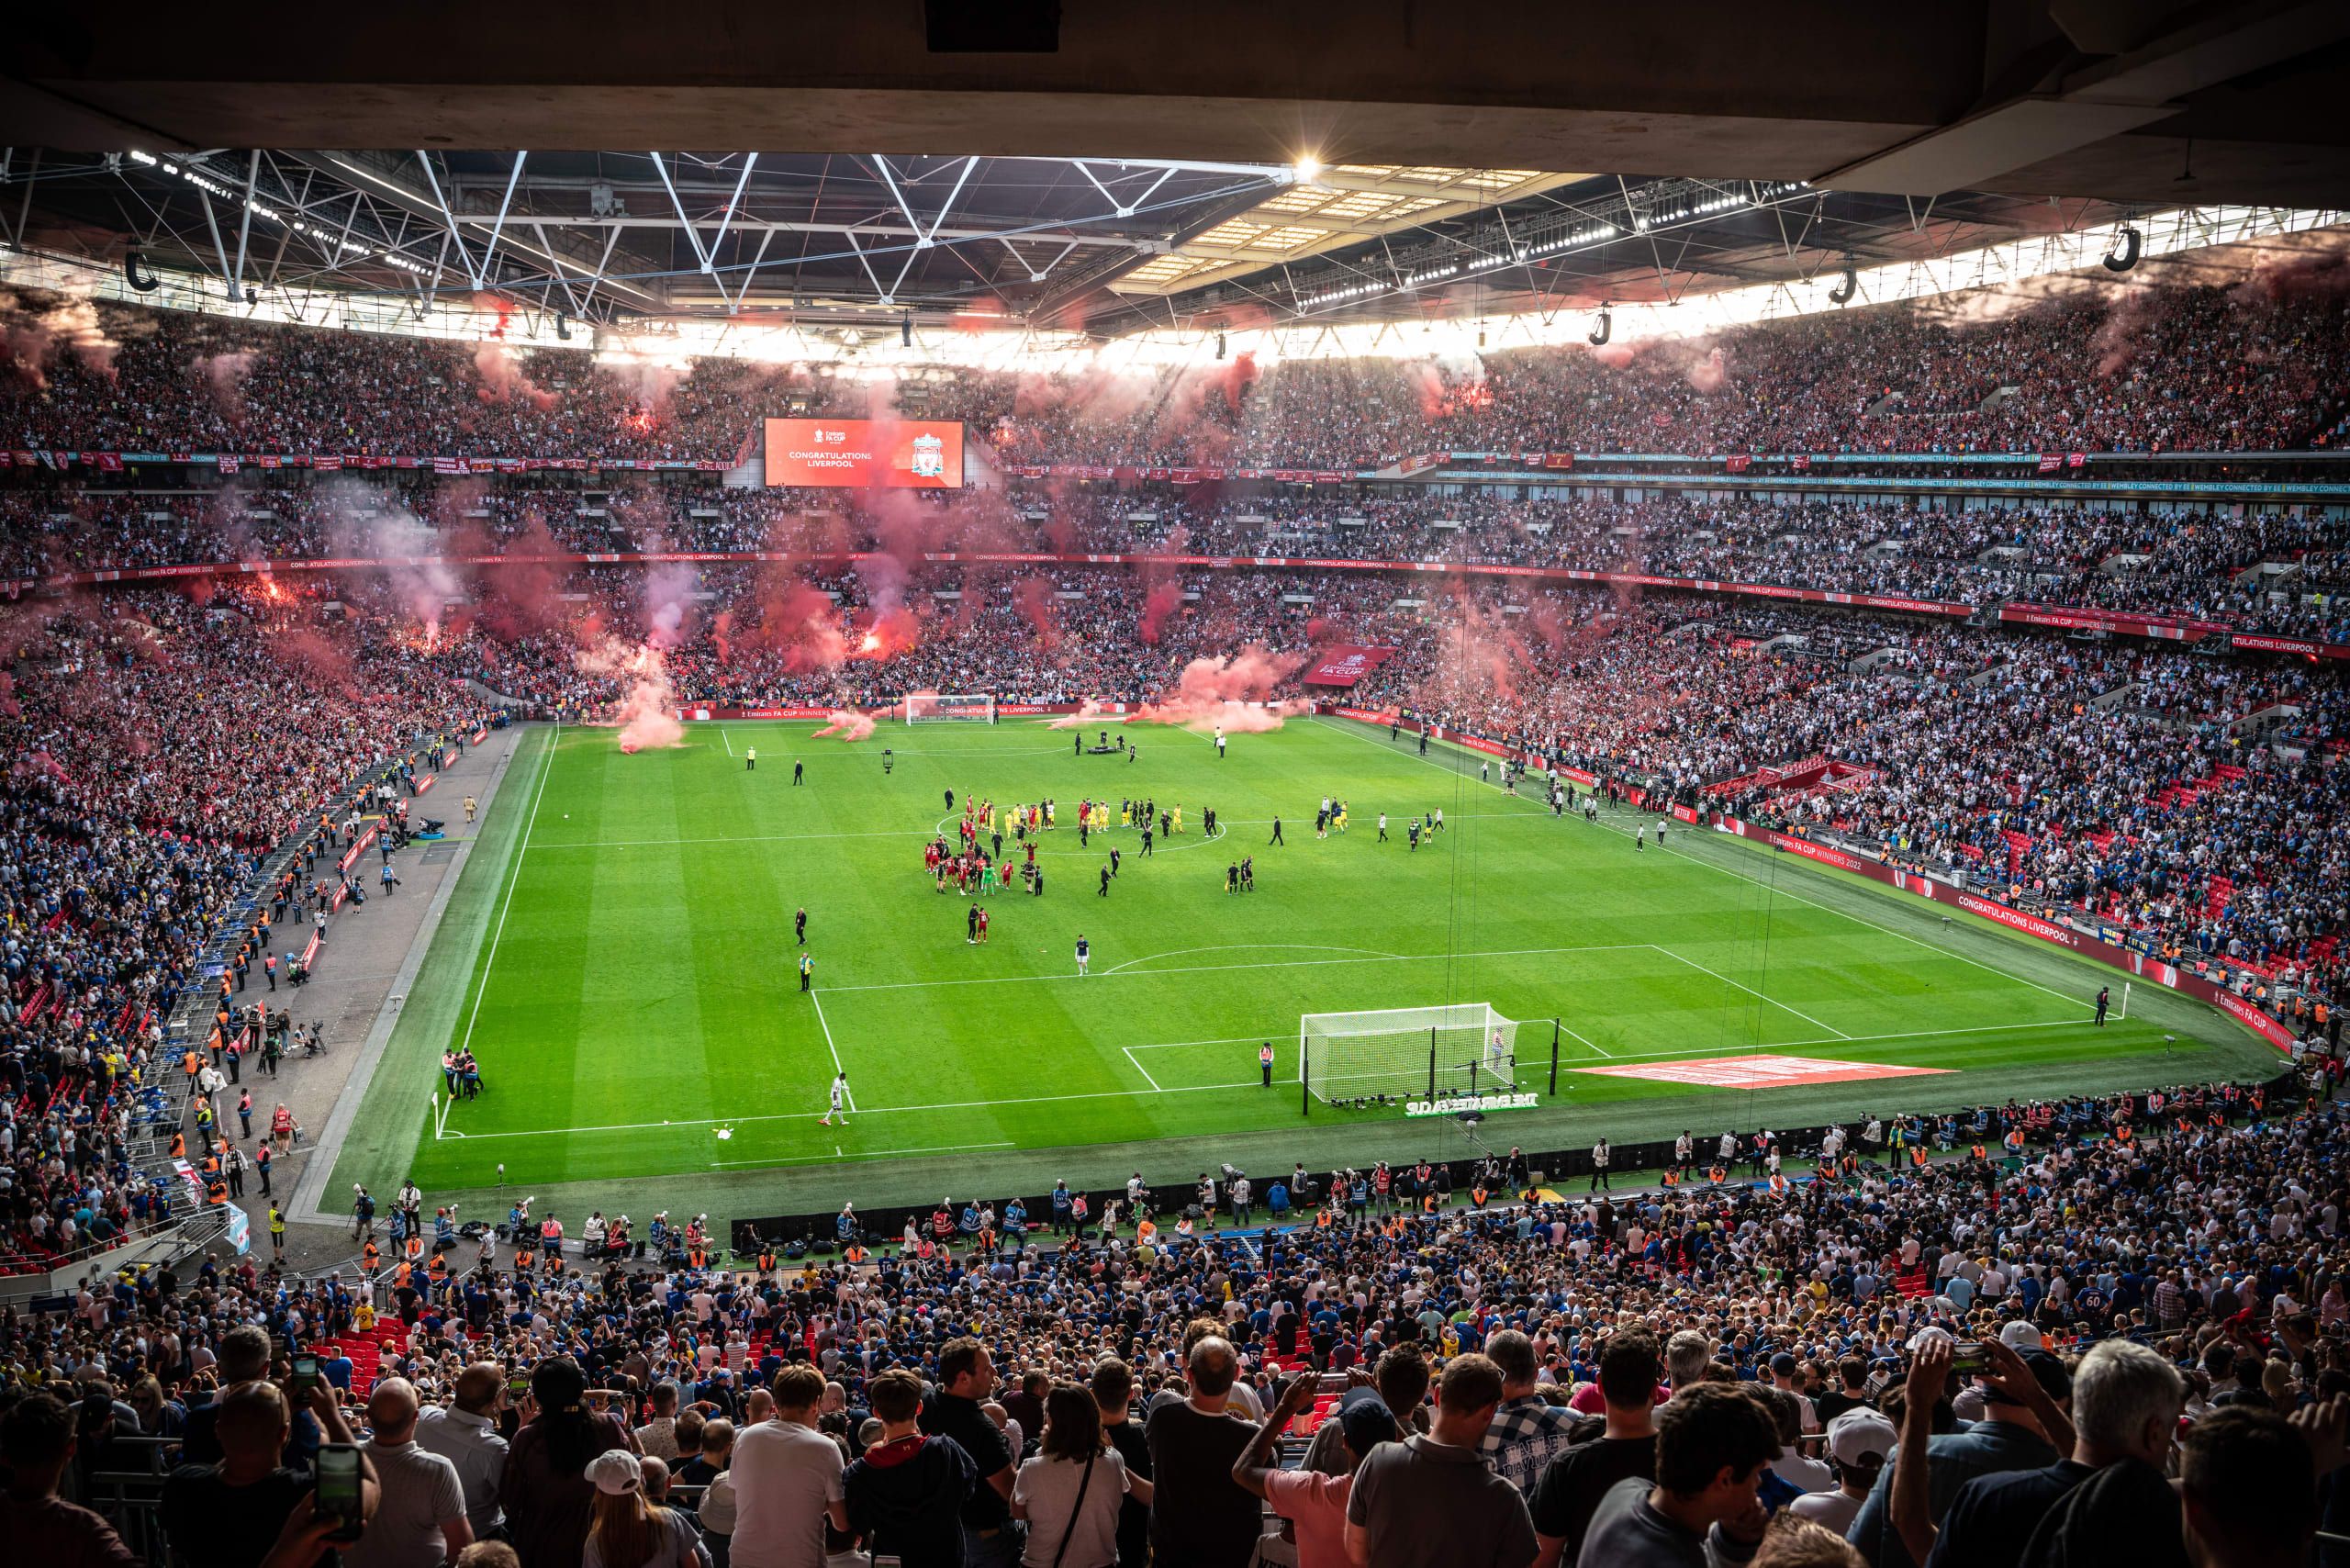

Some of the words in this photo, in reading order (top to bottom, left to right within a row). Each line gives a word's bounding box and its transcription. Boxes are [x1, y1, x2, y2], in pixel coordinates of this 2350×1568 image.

[789, 451, 872, 460] CONGRATULATIONS
[2194, 484, 2224, 492] WEMBLEY
[2225, 484, 2262, 492] CONNECTED
[2264, 484, 2272, 492] BY
[2274, 484, 2280, 492] EE
[1610, 575, 1652, 583] CONGRATULATIONS
[1867, 599, 1915, 610] CONGRATULATIONS
[1915, 602, 1942, 611] LIVERPOOL
[2031, 615, 2051, 624] Emirates
[2100, 622, 2116, 631] 2022
[2275, 642, 2315, 654] LIVERPOOL
[1674, 806, 1691, 819] BETTER
[1774, 834, 1794, 849] Emirates
[1794, 843, 1802, 851] FA
[1803, 845, 1816, 856] CUP
[1817, 848, 1845, 866] WINNERS
[1845, 859, 1862, 870] 2022
[1959, 896, 2027, 928] CONGRATULATIONS
[2029, 919, 2069, 944] LIVERPOOL
[2220, 993, 2244, 1017] Emirates
[2245, 1008, 2253, 1023] FA
[2254, 1014, 2267, 1030] CUP
[2087, 1296, 2100, 1307] 60
[1250, 1353, 1259, 1364] 19
